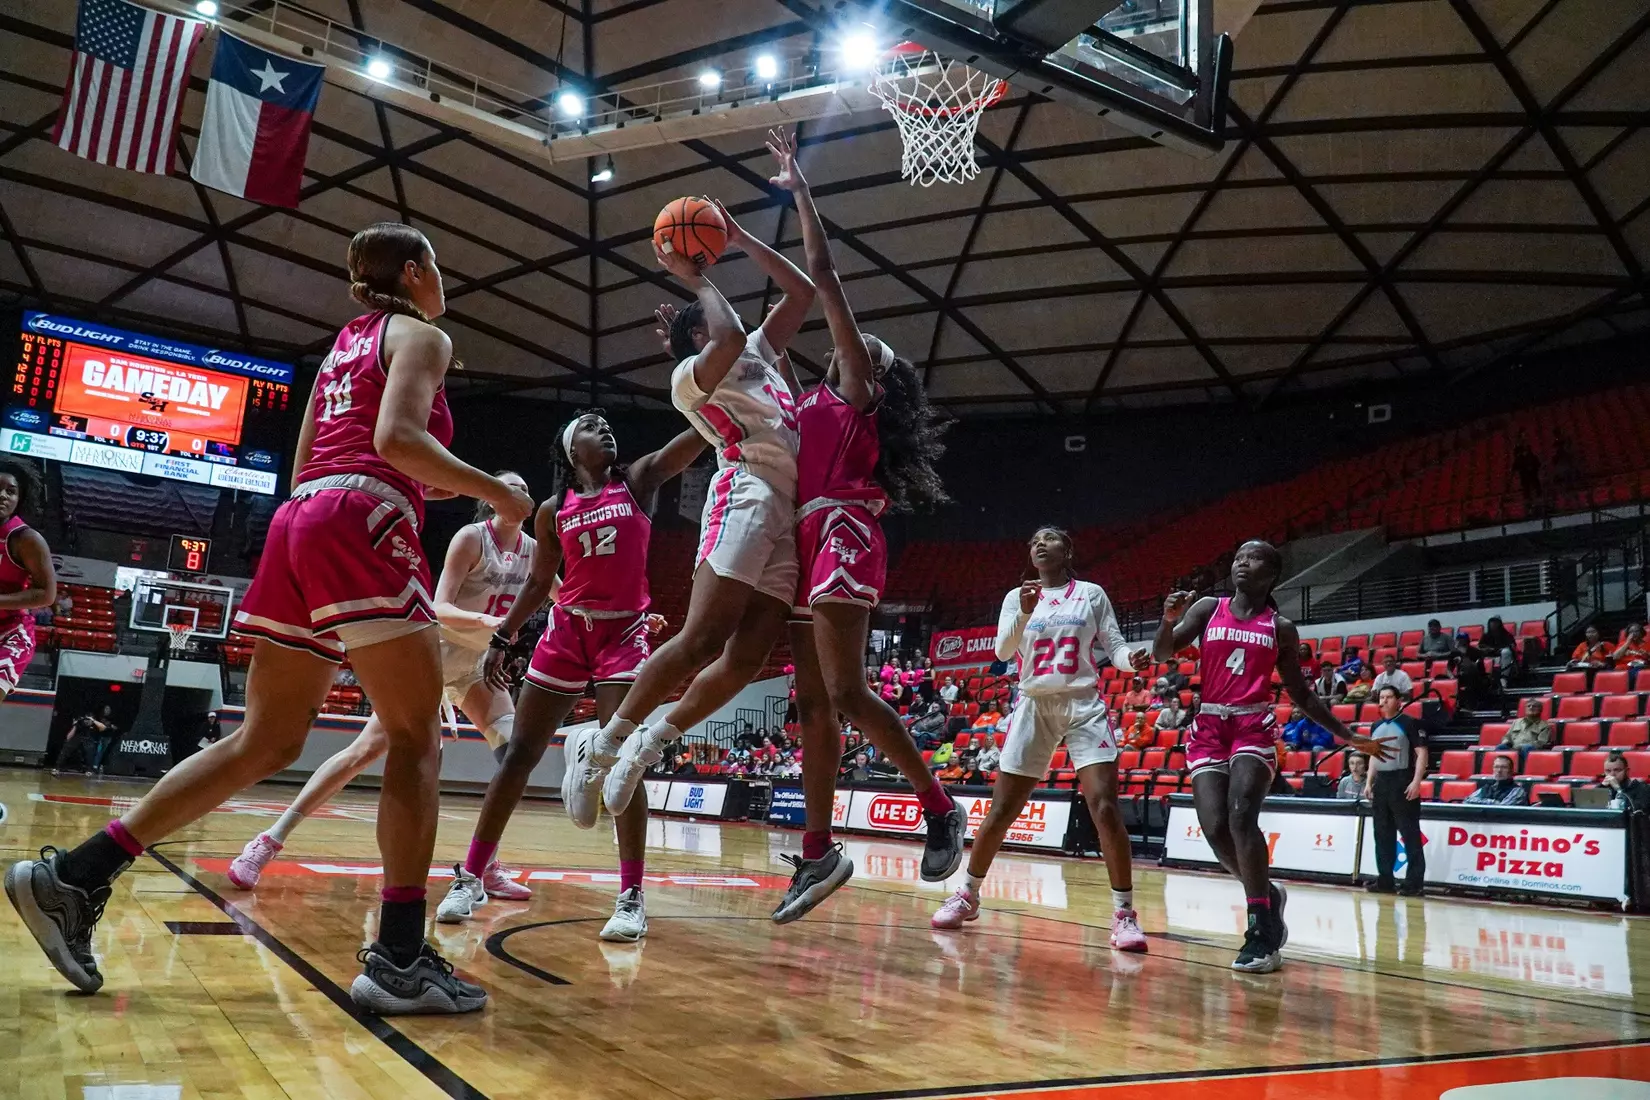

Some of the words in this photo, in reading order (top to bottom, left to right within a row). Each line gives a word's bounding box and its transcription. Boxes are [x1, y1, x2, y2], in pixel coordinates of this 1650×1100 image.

[35, 319, 73, 334] BUD
[73, 328, 124, 344] LIGHT
[47, 337, 61, 347] PTS
[208, 355, 243, 368] BUD
[242, 362, 289, 377] LIGHT
[82, 360, 230, 410] GAMEDAY
[110, 424, 120, 437] 0
[136, 430, 168, 444] 9:37
[192, 439, 202, 450] 0
[154, 463, 200, 475] FINANCIAL
[165, 460, 191, 468] FIRST
[164, 470, 188, 479] BANK
[582, 503, 633, 525] HOUSTON
[182, 540, 206, 552] 9:37
[578, 526, 618, 558] 12
[187, 552, 200, 570] 8
[1206, 626, 1226, 642] SAM
[1227, 628, 1274, 650] HOUSTON
[1033, 636, 1080, 676] 23
[1226, 648, 1246, 676] 4
[120, 740, 168, 750] MEMORIAL
[120, 745, 166, 755] HERMANN
[689, 788, 704, 798] BUD
[684, 798, 704, 808] LIGHT
[1448, 826, 1600, 856] Domino's
[1476, 852, 1564, 878] Pizza
[1458, 874, 1482, 882] Order
[1483, 875, 1510, 886] Online
[1522, 879, 1582, 892] Dominos.com
